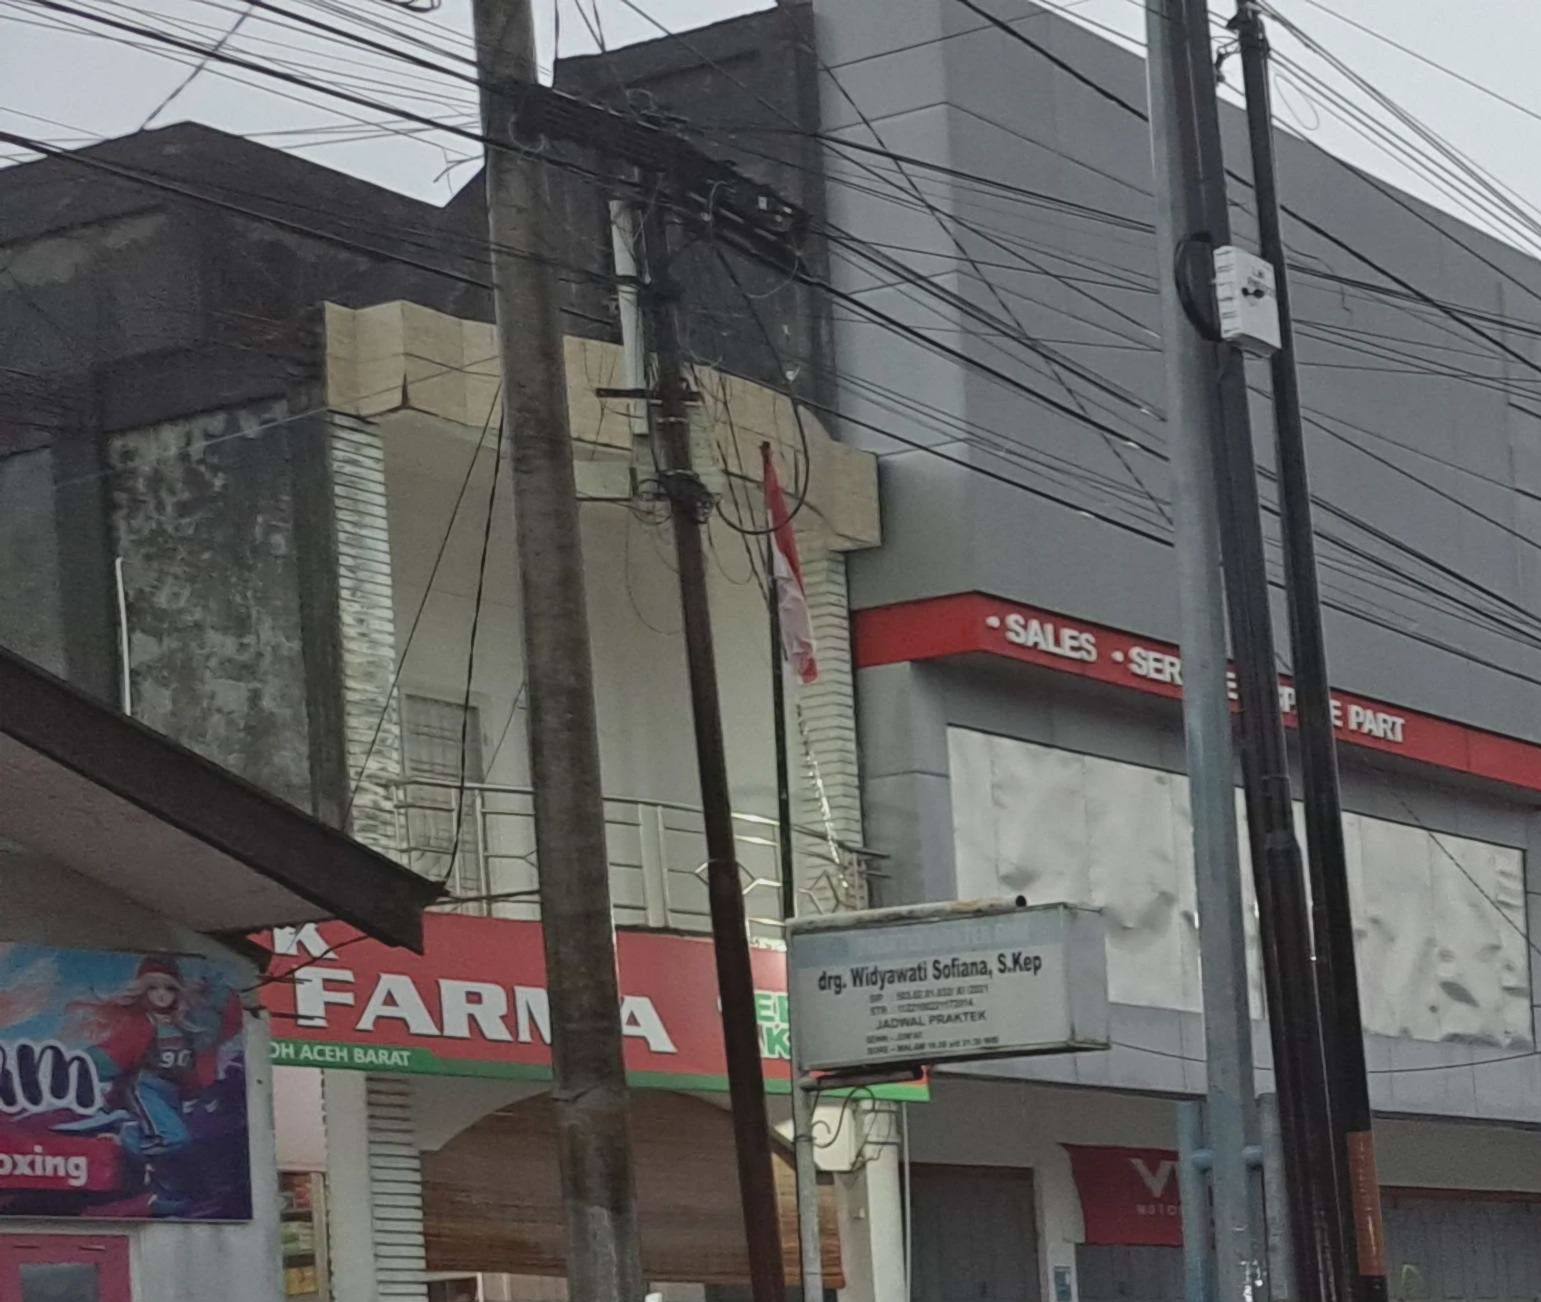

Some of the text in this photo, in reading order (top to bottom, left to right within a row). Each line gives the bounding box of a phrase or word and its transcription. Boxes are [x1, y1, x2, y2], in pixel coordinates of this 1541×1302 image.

[1005, 613, 1098, 663] SALES
[1130, 646, 1240, 701] SERE
[1348, 704, 1405, 743] PART
[817, 948, 1042, 995] drg. Widyawati Sofiana, S.Kep
[875, 1009, 986, 1030] JADWAL PRAKTEK
[299, 1044, 348, 1063] ACEH
[354, 1049, 411, 1067] BARAT
